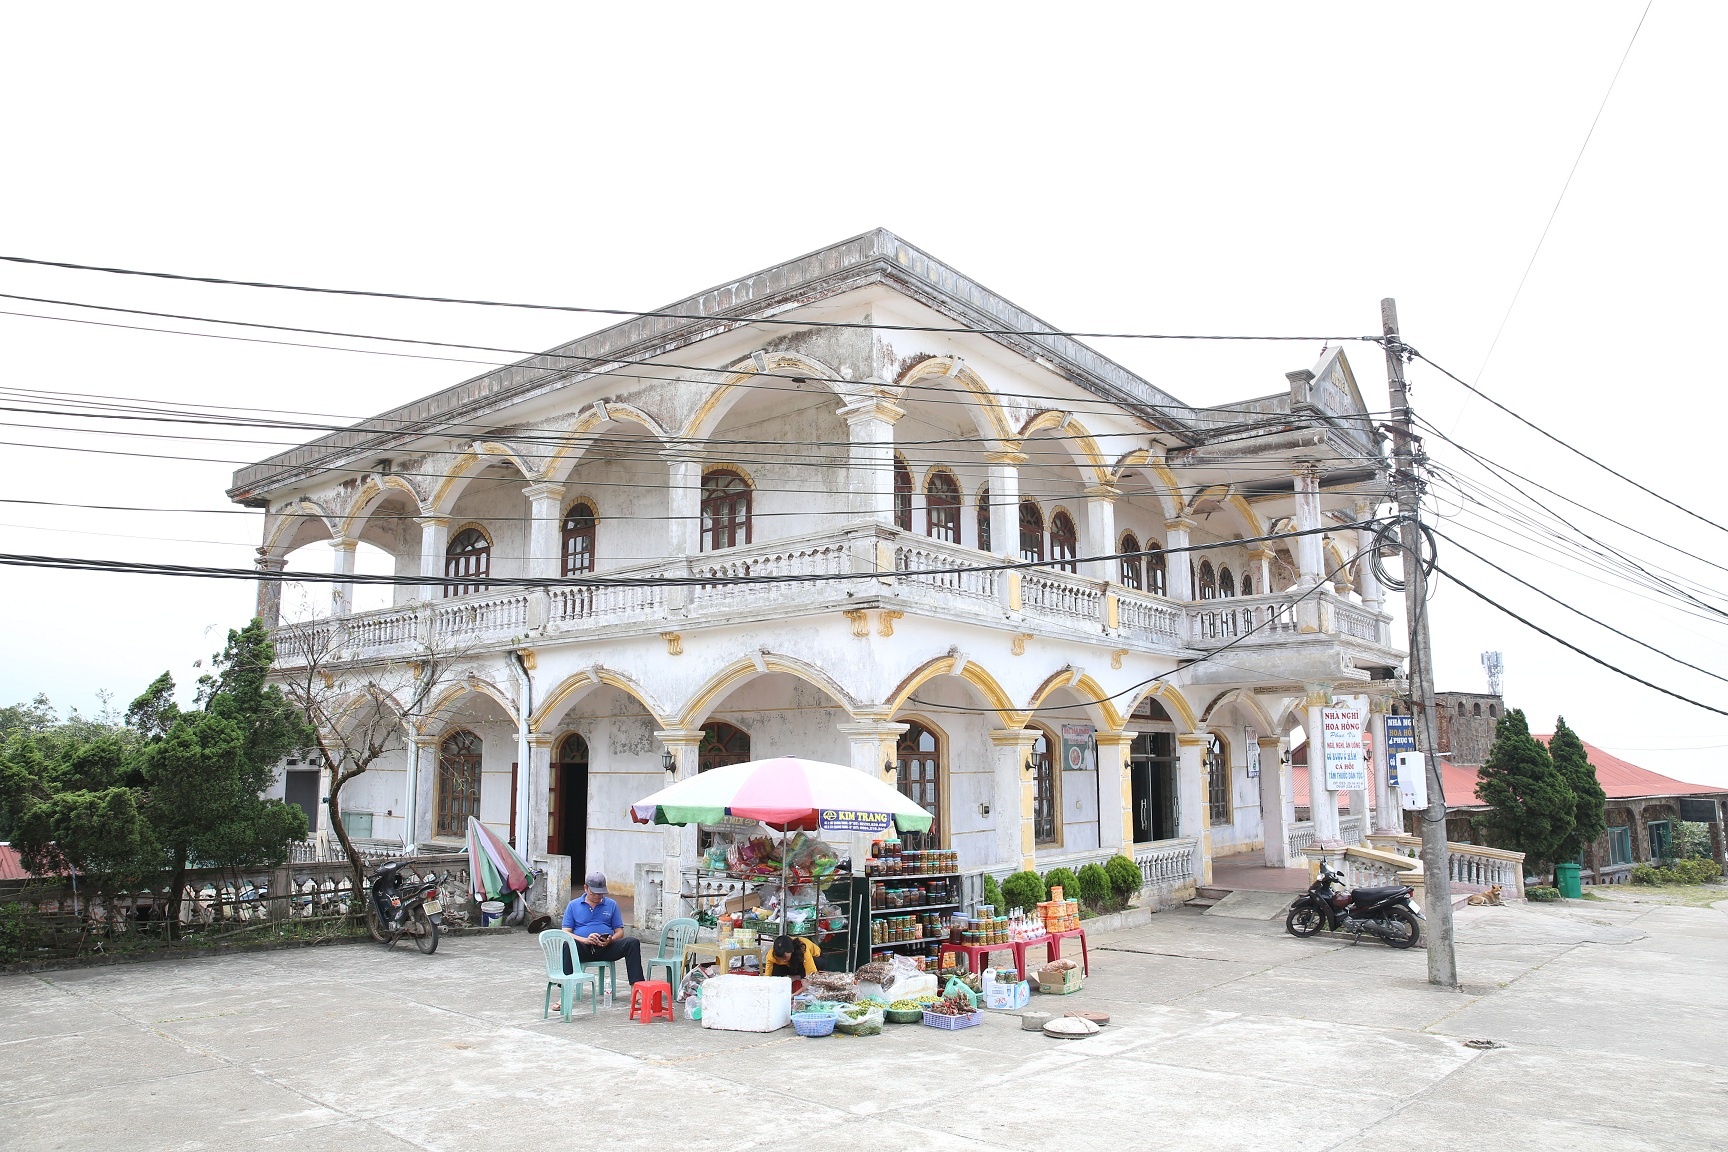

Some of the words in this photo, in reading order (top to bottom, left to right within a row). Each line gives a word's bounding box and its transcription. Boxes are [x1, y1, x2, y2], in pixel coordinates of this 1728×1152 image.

[1325, 711, 1340, 719] NHÀ
[1388, 718, 1402, 726] NHÀ
[1393, 737, 1407, 745] PHỤC
[839, 811, 855, 820] KIM
[857, 813, 887, 822] TRANG
